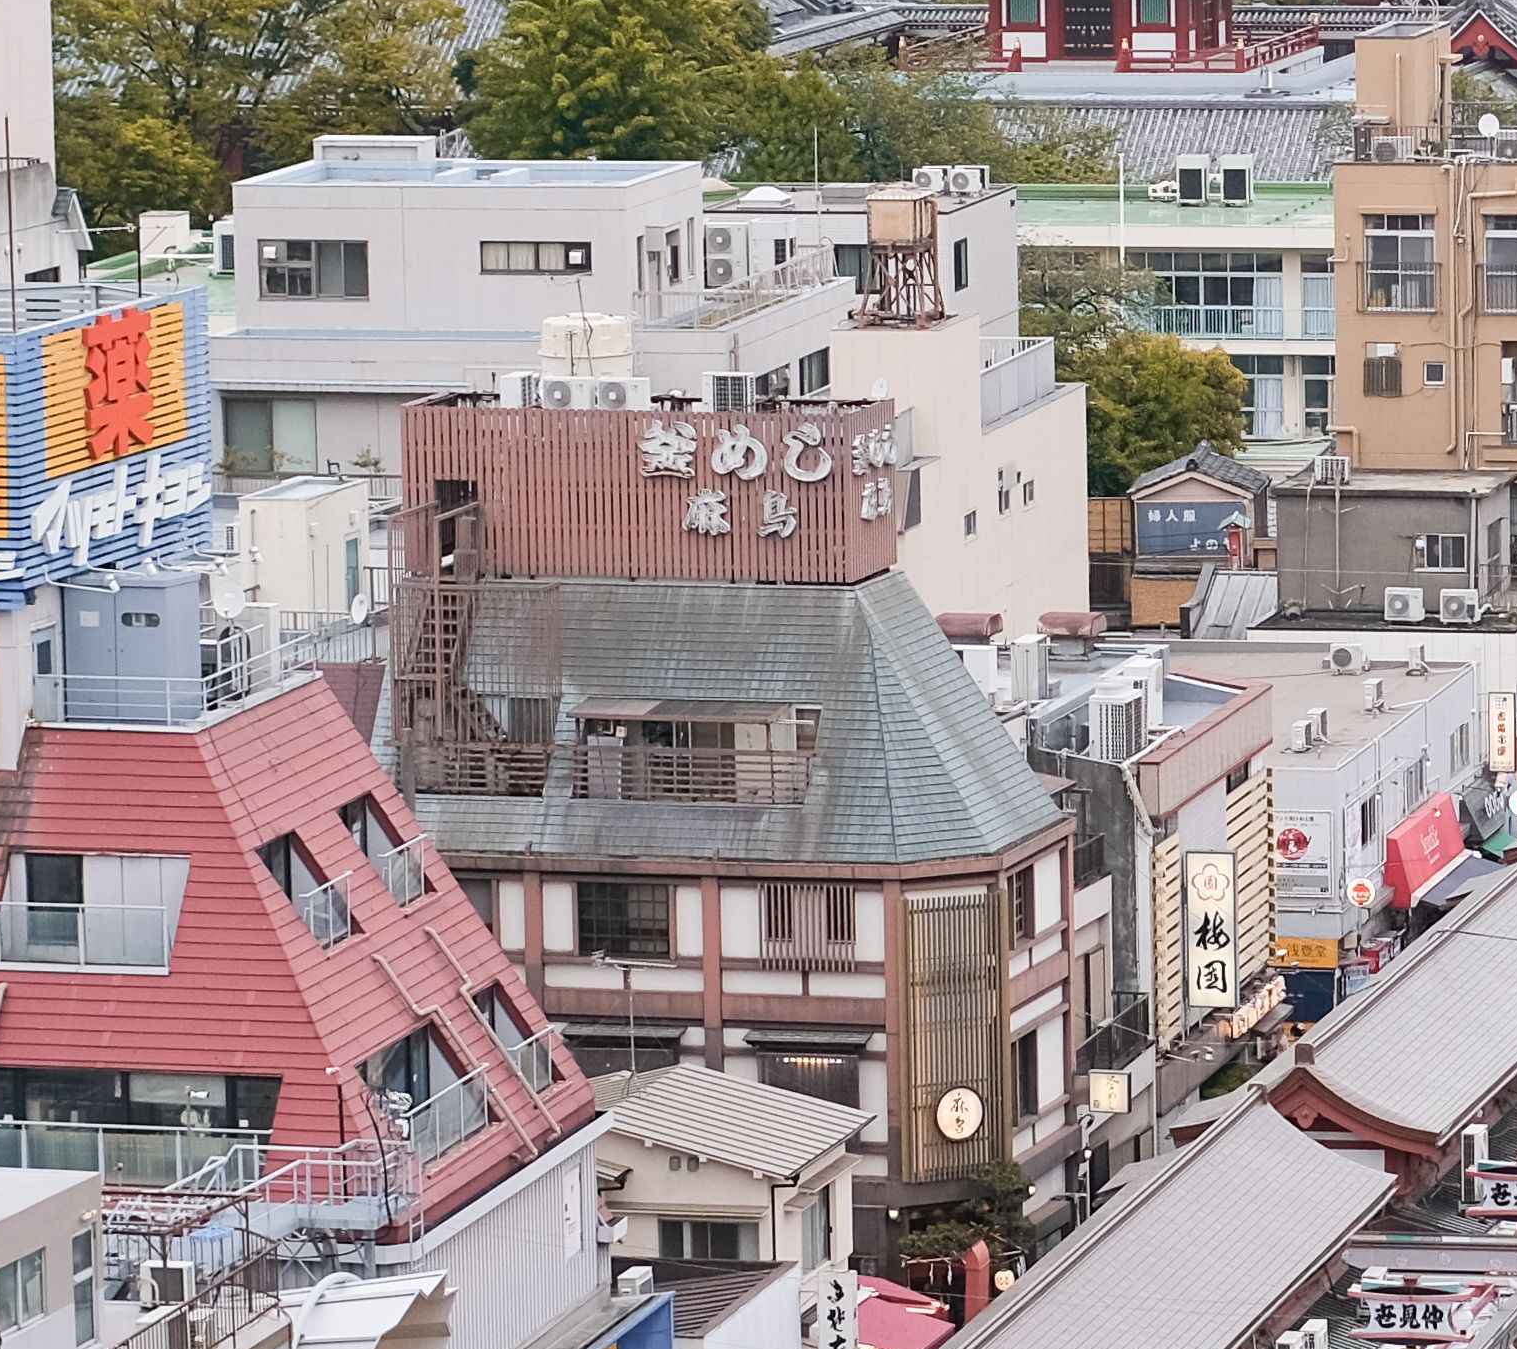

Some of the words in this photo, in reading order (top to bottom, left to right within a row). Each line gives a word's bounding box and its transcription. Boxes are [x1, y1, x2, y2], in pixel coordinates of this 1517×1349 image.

[82, 306, 155, 458] 薬
[638, 419, 833, 483] 釜めし
[30, 454, 213, 566] マツモトキヨシ
[682, 488, 798, 539] 麻鳥
[1147, 509, 1196, 523] 婦人服
[1194, 910, 1231, 994] 梅園
